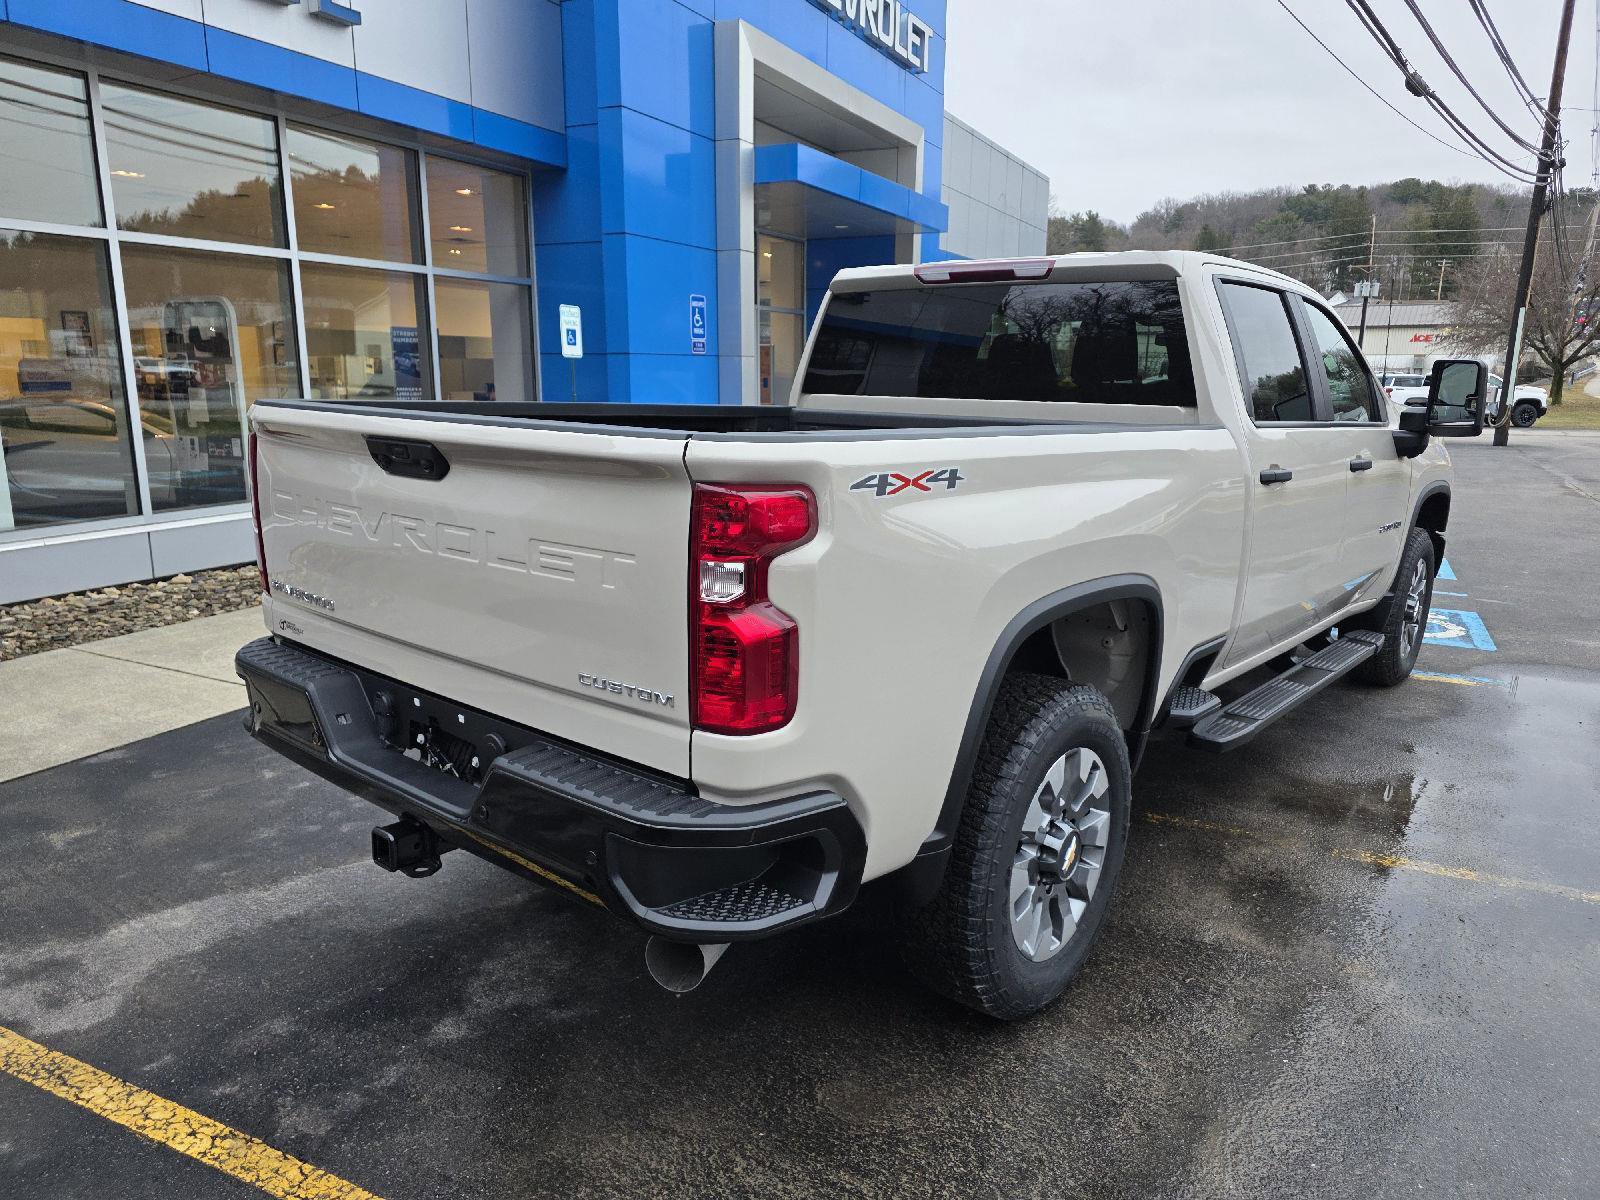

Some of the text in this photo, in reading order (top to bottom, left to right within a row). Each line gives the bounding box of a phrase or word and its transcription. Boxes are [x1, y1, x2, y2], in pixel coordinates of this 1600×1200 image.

[1408, 333, 1434, 343] ACE
[272, 488, 636, 590] CHEVROLET
[578, 672, 675, 708] CUSTOM
